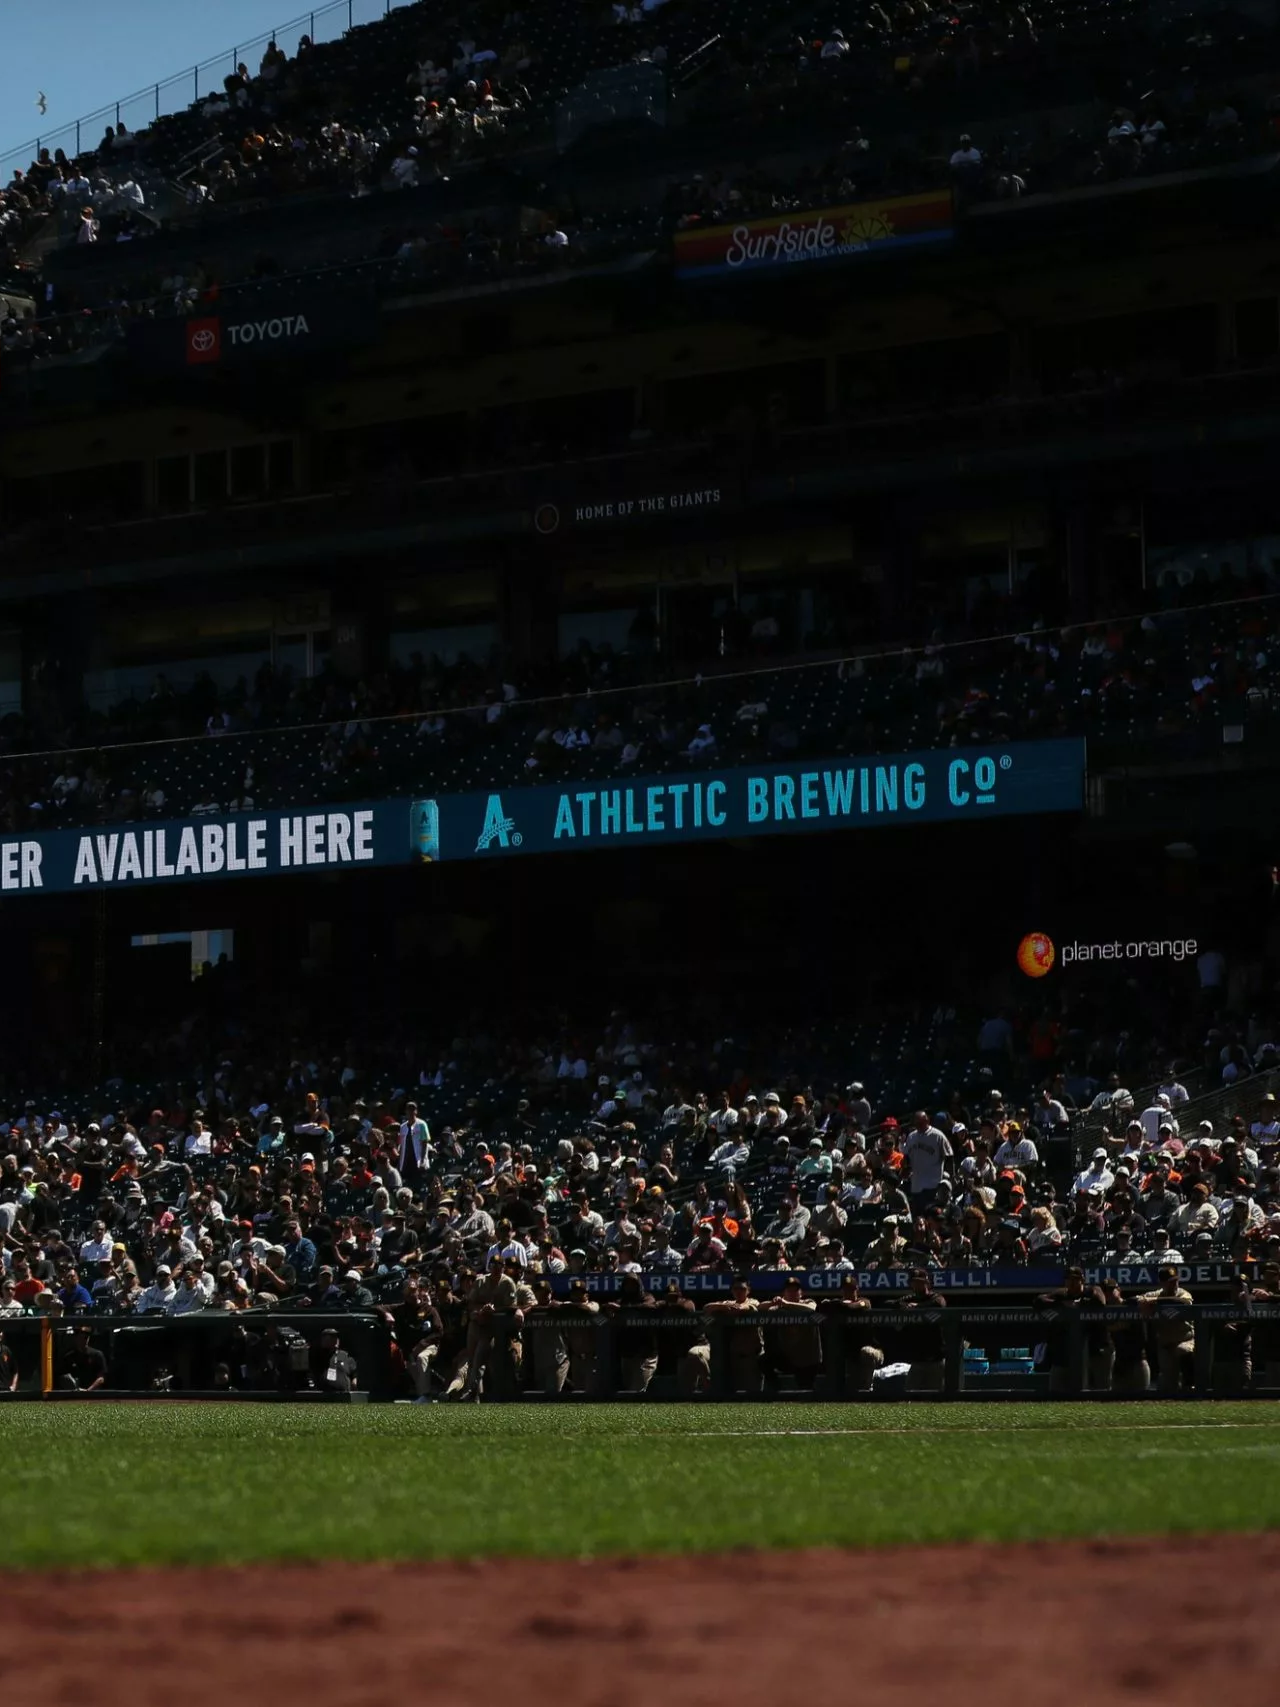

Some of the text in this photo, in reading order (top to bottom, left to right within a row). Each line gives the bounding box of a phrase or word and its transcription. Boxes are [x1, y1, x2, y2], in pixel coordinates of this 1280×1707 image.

[726, 216, 835, 266] Surfside
[227, 314, 310, 345] TOYOTA
[576, 488, 721, 521] HOME OF THE GIANTS
[553, 780, 728, 839] ATHLETIC
[747, 763, 927, 823] BREWING
[73, 819, 267, 884] AVAILABLE
[280, 810, 374, 867] HERE
[1061, 938, 1198, 967] planet orange
[961, 1313, 985, 1322] BANK
[1000, 1312, 1040, 1321] AMERICA
[1080, 1312, 1104, 1321] BANK
